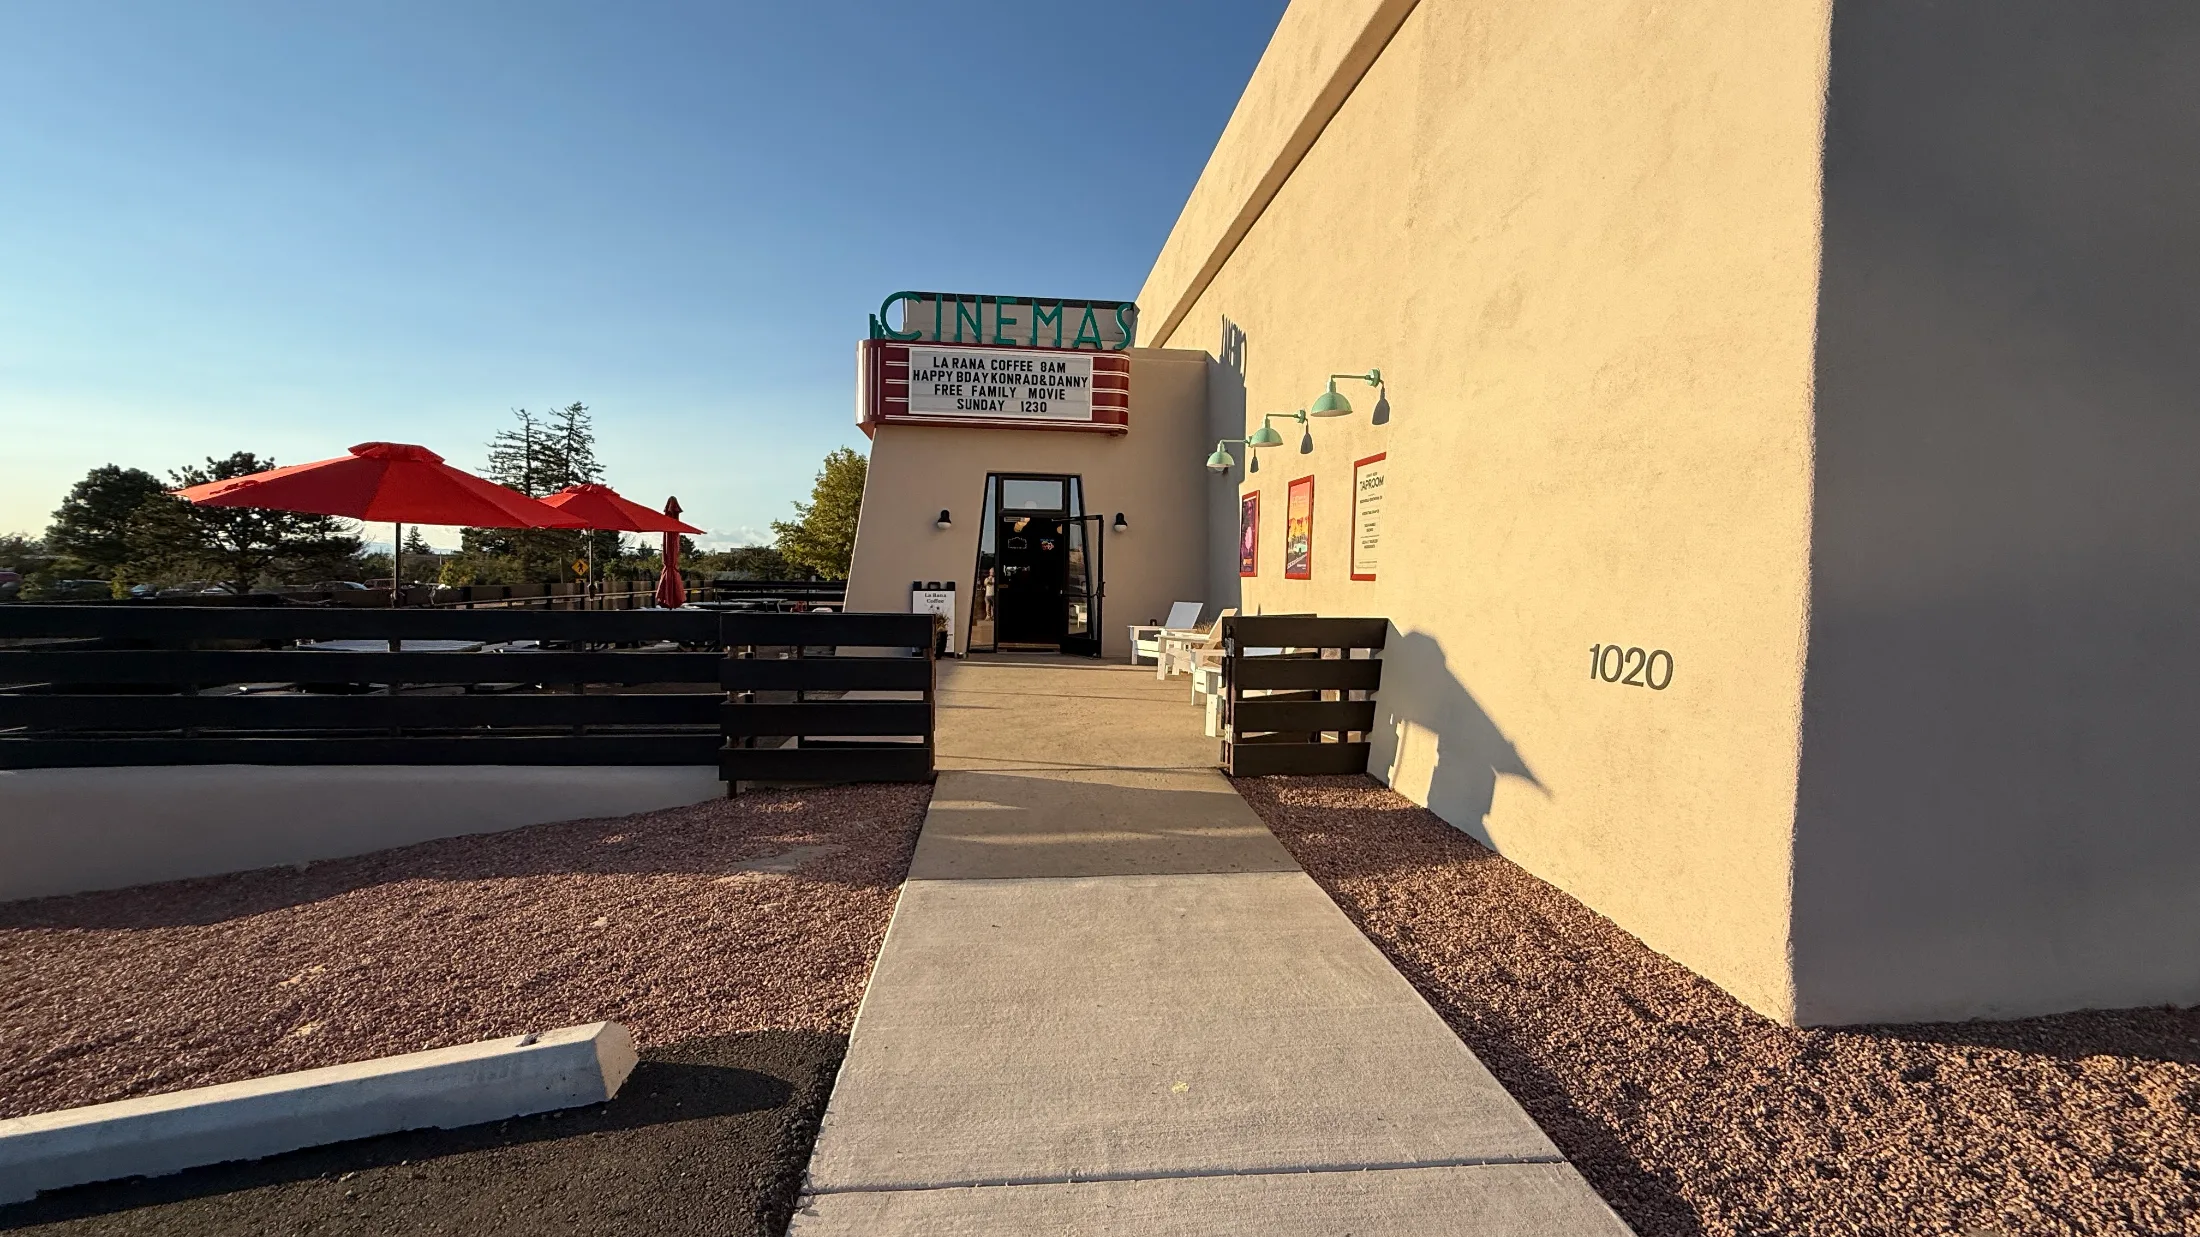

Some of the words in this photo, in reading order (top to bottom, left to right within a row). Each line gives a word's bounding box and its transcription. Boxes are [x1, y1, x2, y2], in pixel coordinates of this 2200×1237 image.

[880, 291, 1133, 350] CINEMAS
[933, 356, 949, 369] LA
[952, 358, 985, 370] RANA
[991, 359, 1033, 372] COFFEE
[1040, 361, 1066, 373] 8AM
[913, 370, 953, 382] HAPPY
[956, 371, 989, 384] BDAY
[991, 373, 1088, 388] KONRAD&DANNY
[934, 384, 963, 396] FREE
[971, 385, 1017, 398] FAMILY
[1028, 387, 1066, 400] MOVIE
[957, 398, 1005, 411] SUNDAY
[1021, 401, 1047, 413] 1230
[1360, 475, 1384, 491] TAPROOM
[1589, 643, 1674, 691] 1020
